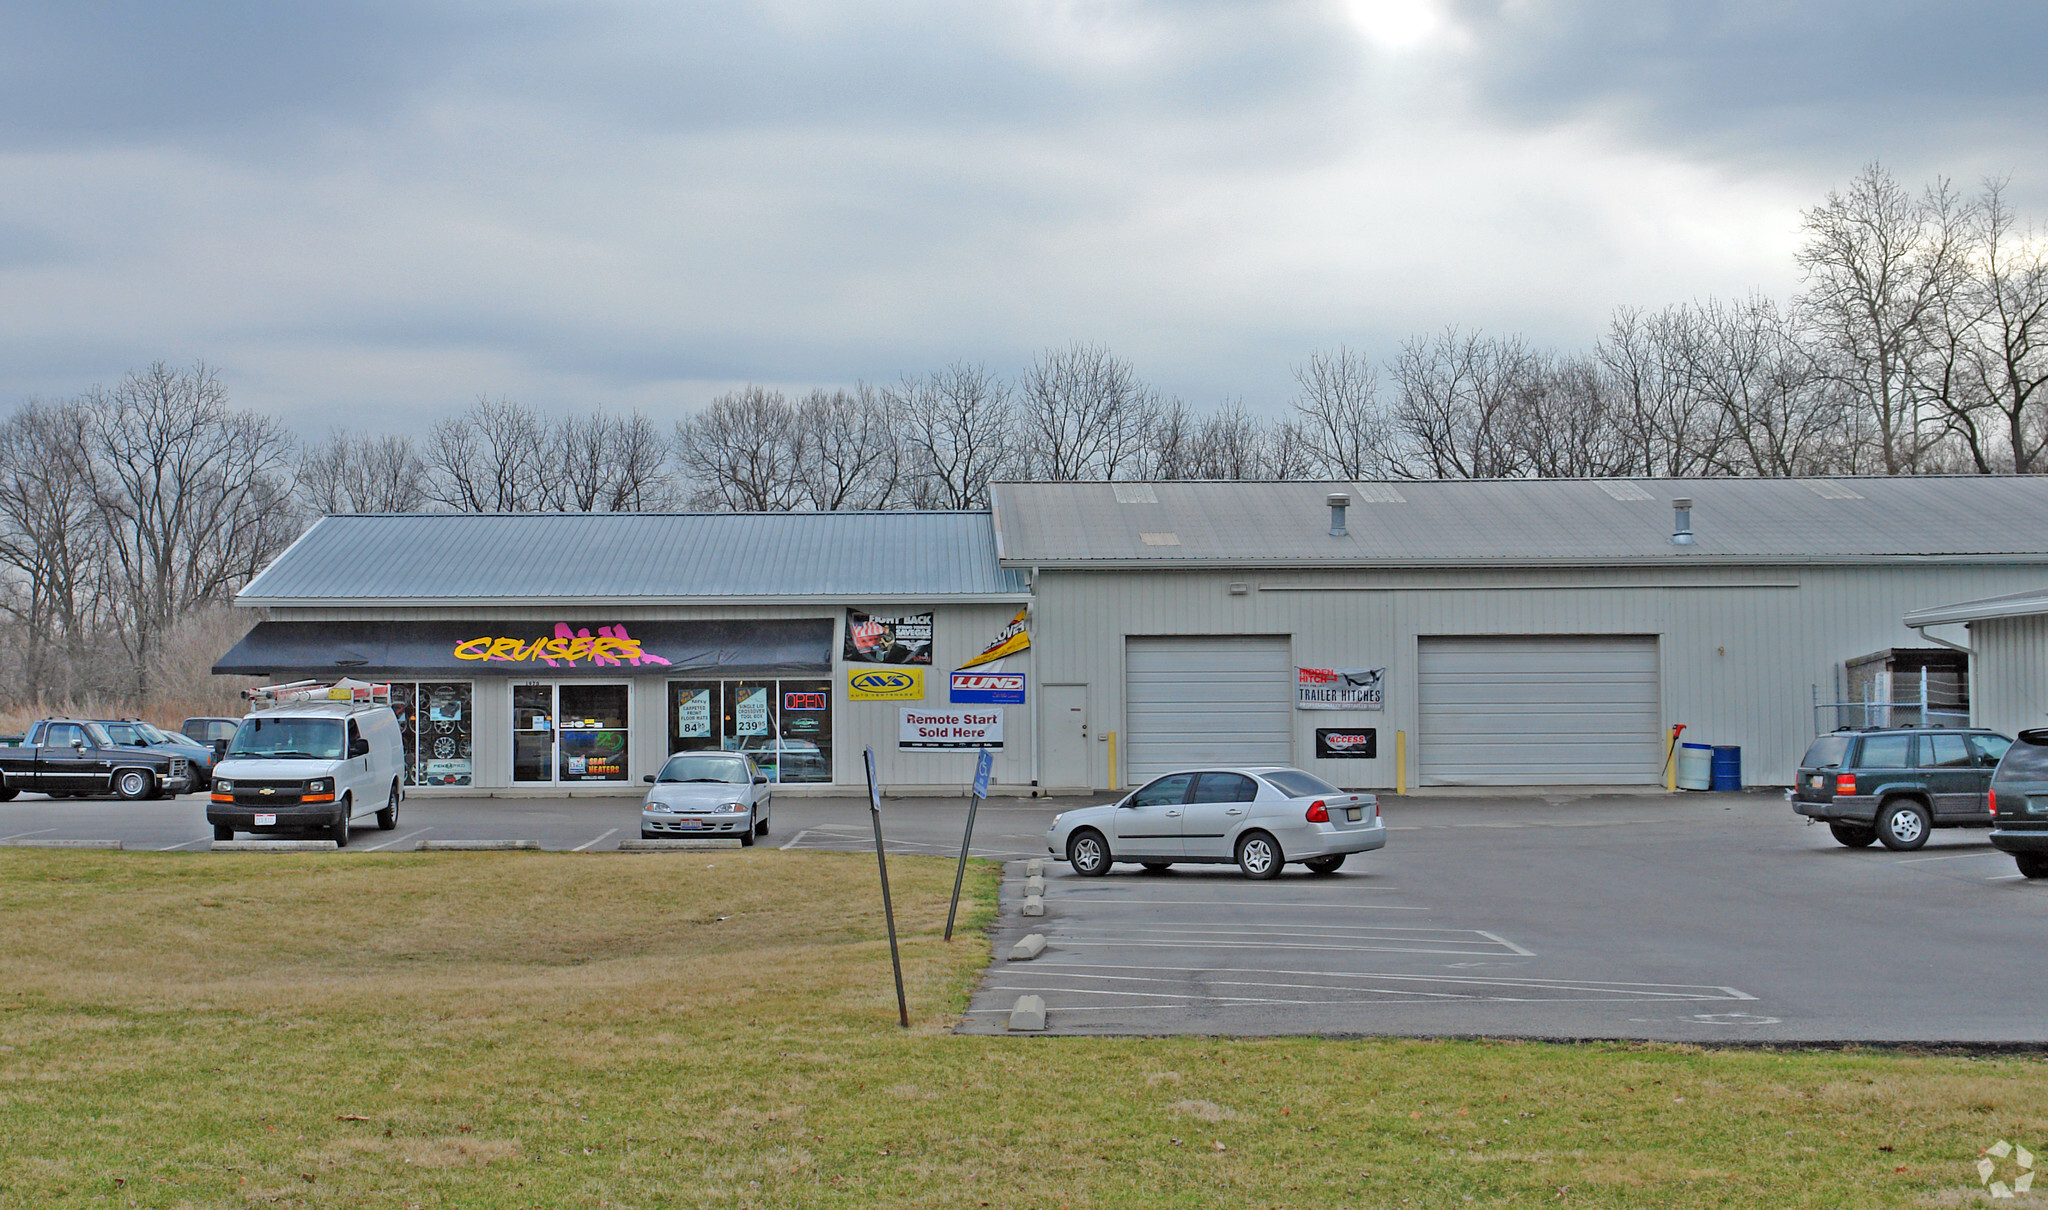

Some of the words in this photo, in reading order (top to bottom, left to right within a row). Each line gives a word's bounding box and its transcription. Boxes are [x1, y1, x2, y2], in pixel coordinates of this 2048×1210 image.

[904, 615, 931, 624] BACK
[454, 636, 641, 662] CRUISERS
[1299, 668, 1334, 676] HIDDEN
[857, 675, 904, 687] AVS
[954, 677, 1022, 689] LUND
[1299, 675, 1327, 683] HITCH
[1299, 689, 1337, 701] TRAILER
[1342, 689, 1381, 702] HITCHES
[786, 694, 825, 709] OPEN
[907, 714, 959, 724] Remote
[963, 714, 998, 724] Start
[919, 727, 948, 737] Sold
[953, 727, 985, 737] Here
[589, 757, 607, 765] SEAT
[588, 765, 620, 774] HEATERS
